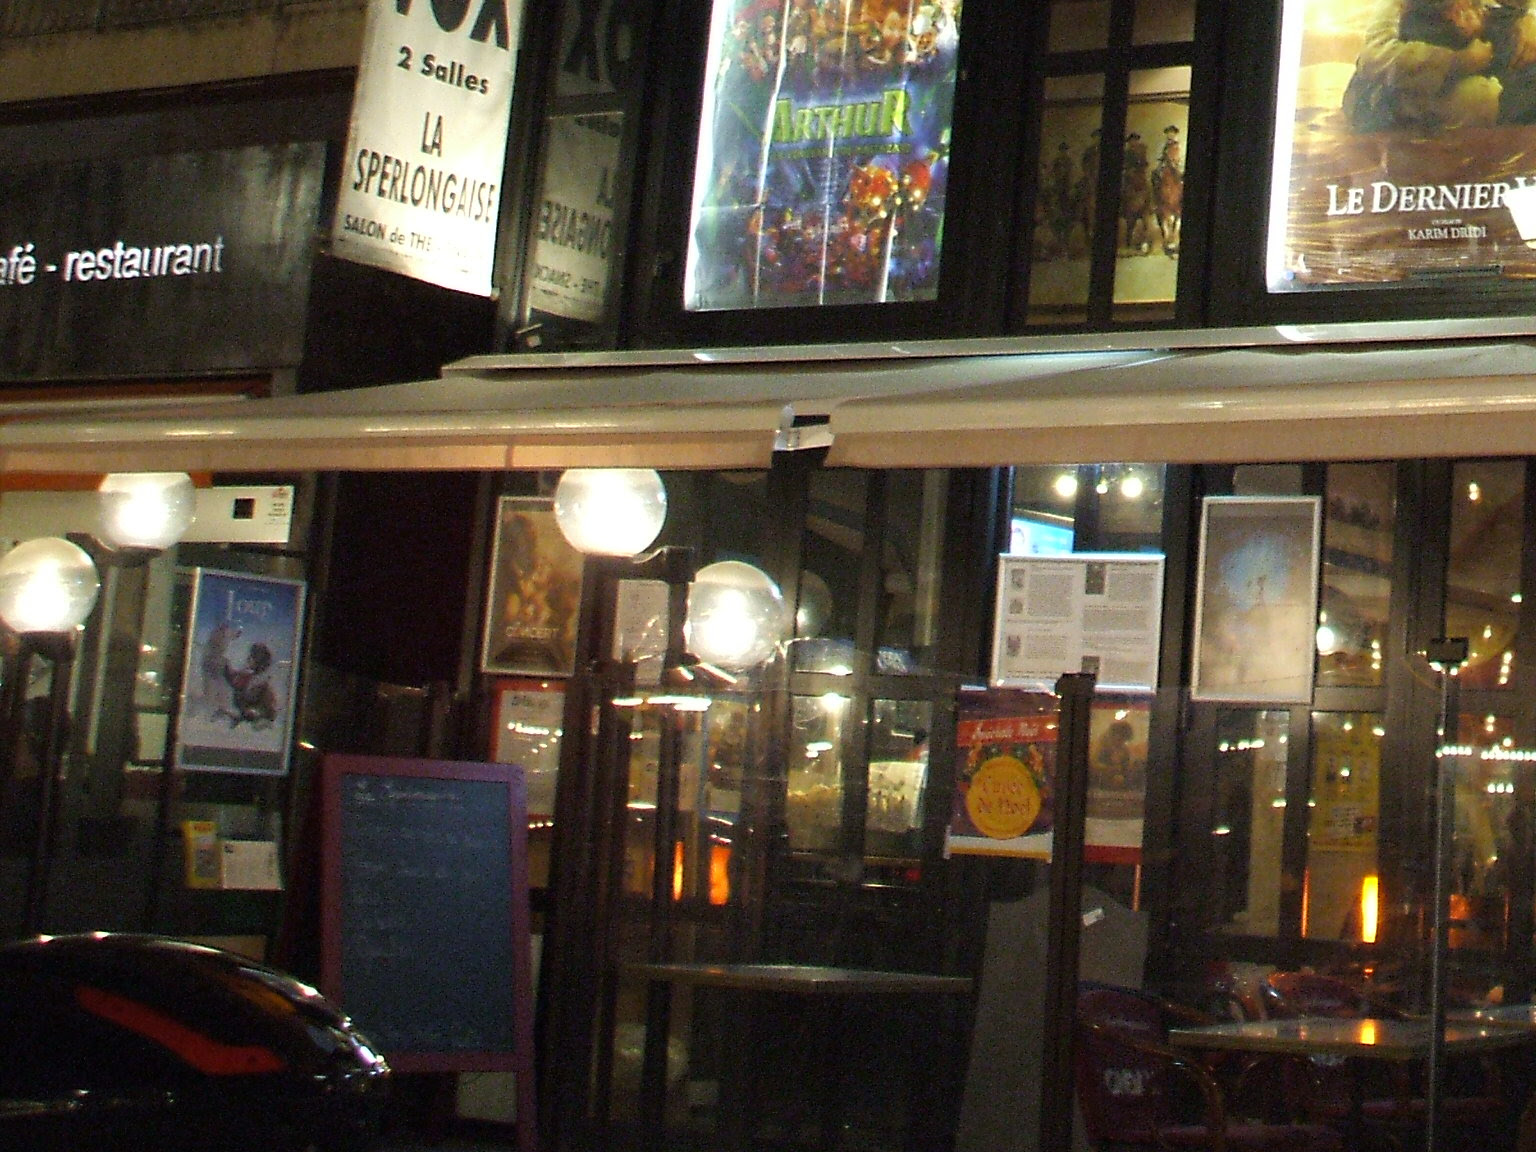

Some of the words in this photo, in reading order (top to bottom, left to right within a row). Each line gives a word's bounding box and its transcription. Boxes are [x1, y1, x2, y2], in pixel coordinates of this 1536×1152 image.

[398, 46, 413, 70] 2
[421, 53, 489, 95] Salles
[421, 111, 443, 157] LA
[772, 90, 913, 142] ARTHUR
[354, 149, 495, 223] SPERLONGAISE
[1326, 184, 1364, 216] LE
[1371, 181, 1510, 215] DERNIER
[344, 214, 386, 240] SALON
[389, 227, 405, 245] de
[1408, 228, 1449, 241] KARIM
[64, 236, 224, 282] restaurant
